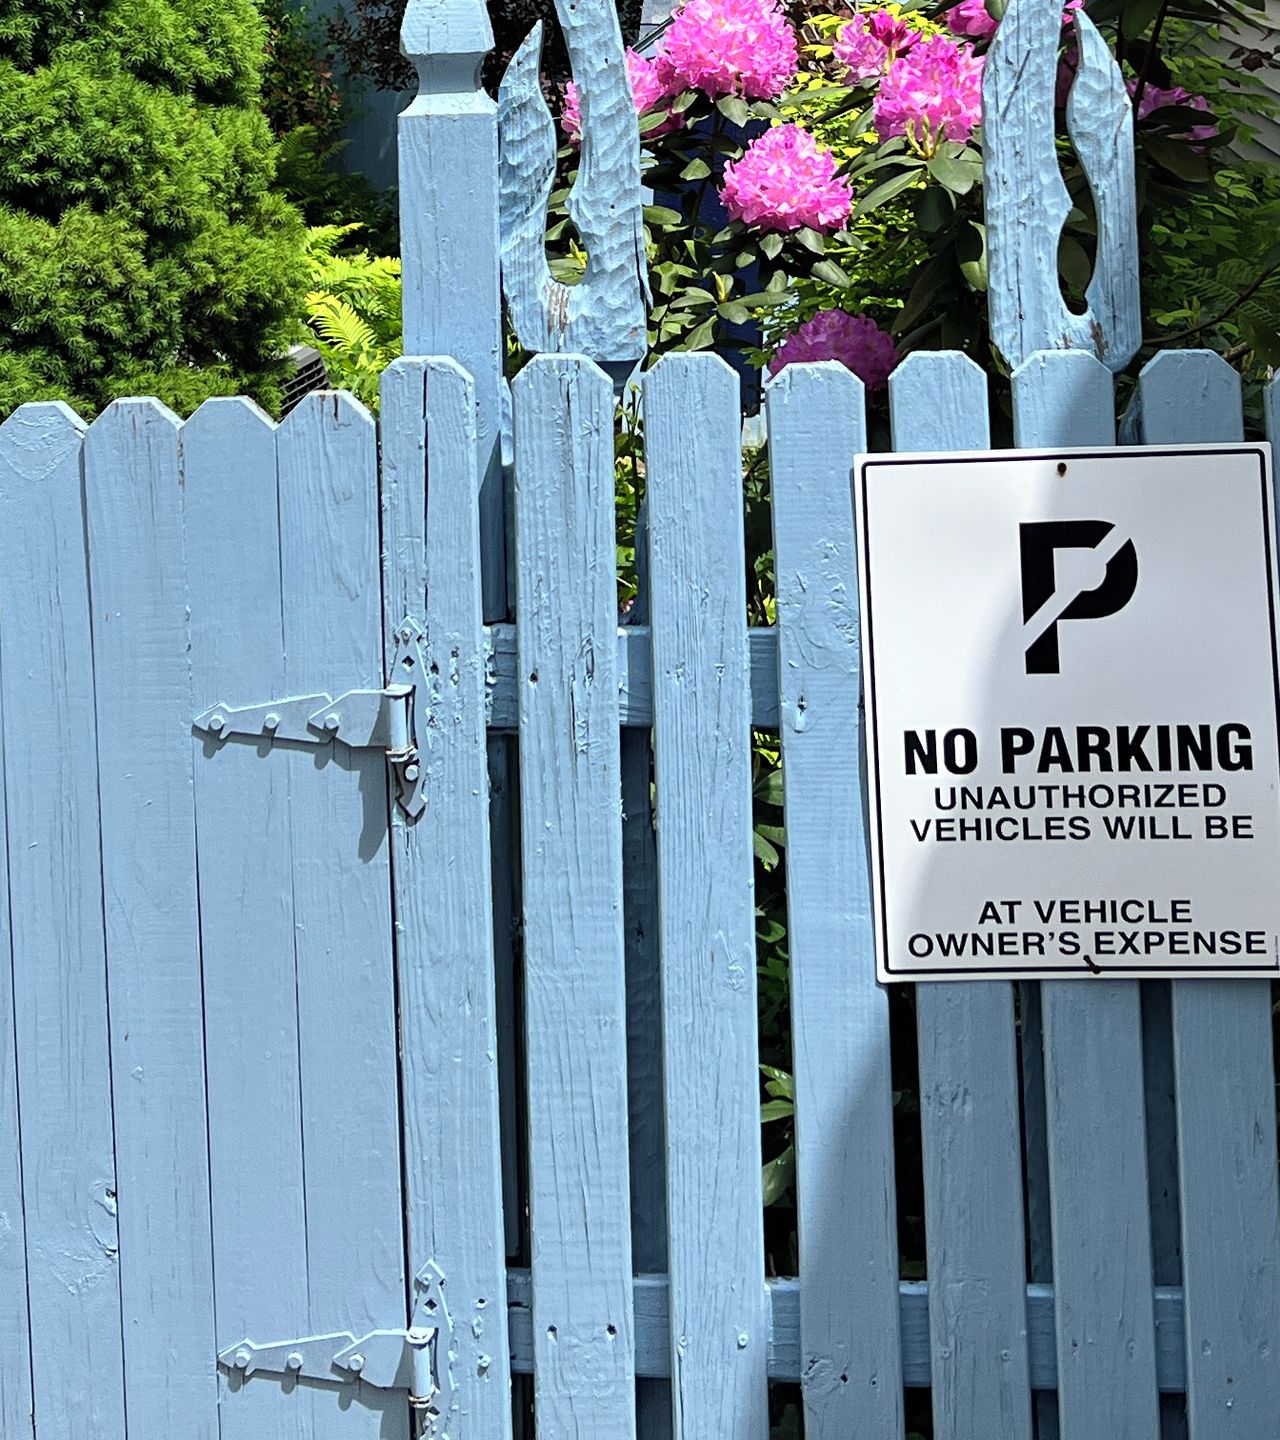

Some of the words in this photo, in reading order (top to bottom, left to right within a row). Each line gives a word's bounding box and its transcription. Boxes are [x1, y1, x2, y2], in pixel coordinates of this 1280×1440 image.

[1019, 520, 1139, 675] P
[903, 728, 978, 776] NO
[1000, 722, 1254, 775] PARKING
[934, 783, 1227, 811] UNAUTHORIZED
[910, 815, 1091, 842] VEHICLES
[1102, 815, 1193, 840] WILL
[1205, 815, 1254, 840] BE
[978, 900, 1022, 925] AT
[1033, 899, 1193, 924] VEHICLE
[908, 931, 1081, 957] OWNER'S
[1094, 930, 1267, 955] EXPENSE
